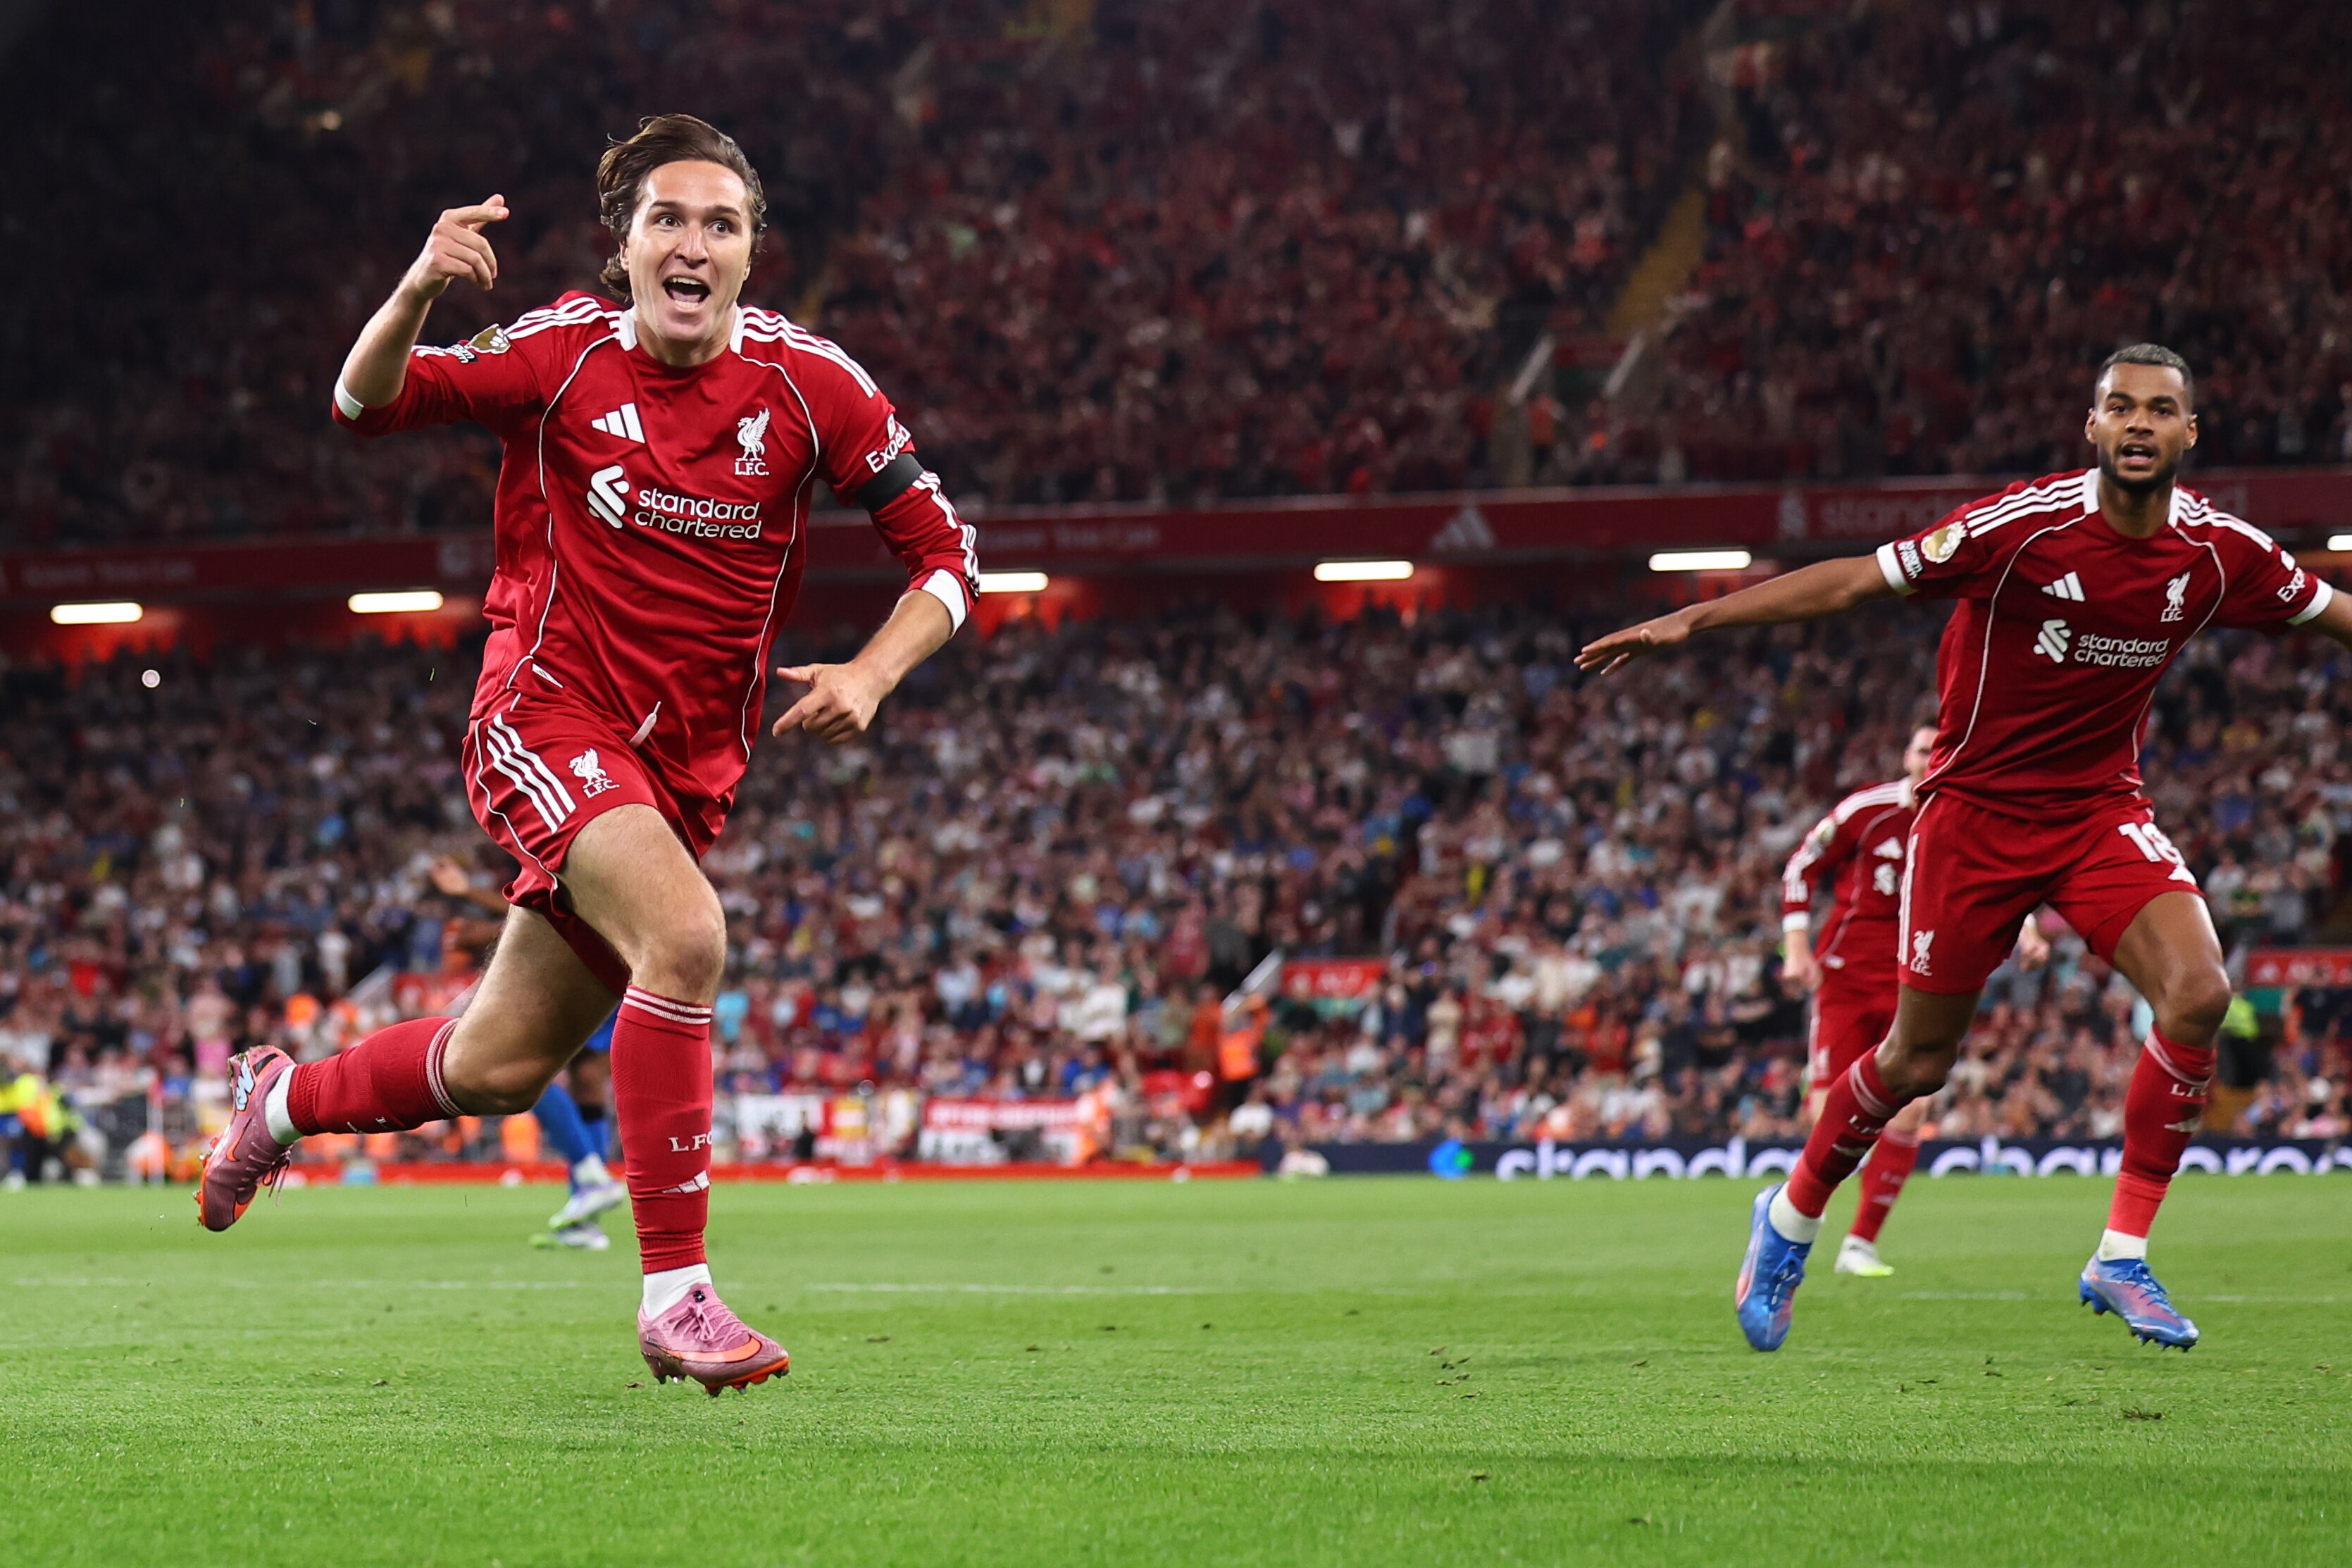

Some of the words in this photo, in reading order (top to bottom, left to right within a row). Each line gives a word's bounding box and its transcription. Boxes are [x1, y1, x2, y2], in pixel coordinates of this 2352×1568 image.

[637, 488, 761, 521] standard
[634, 510, 762, 540] chartered
[2077, 633, 2170, 654] standard
[2074, 649, 2169, 667] chartered
